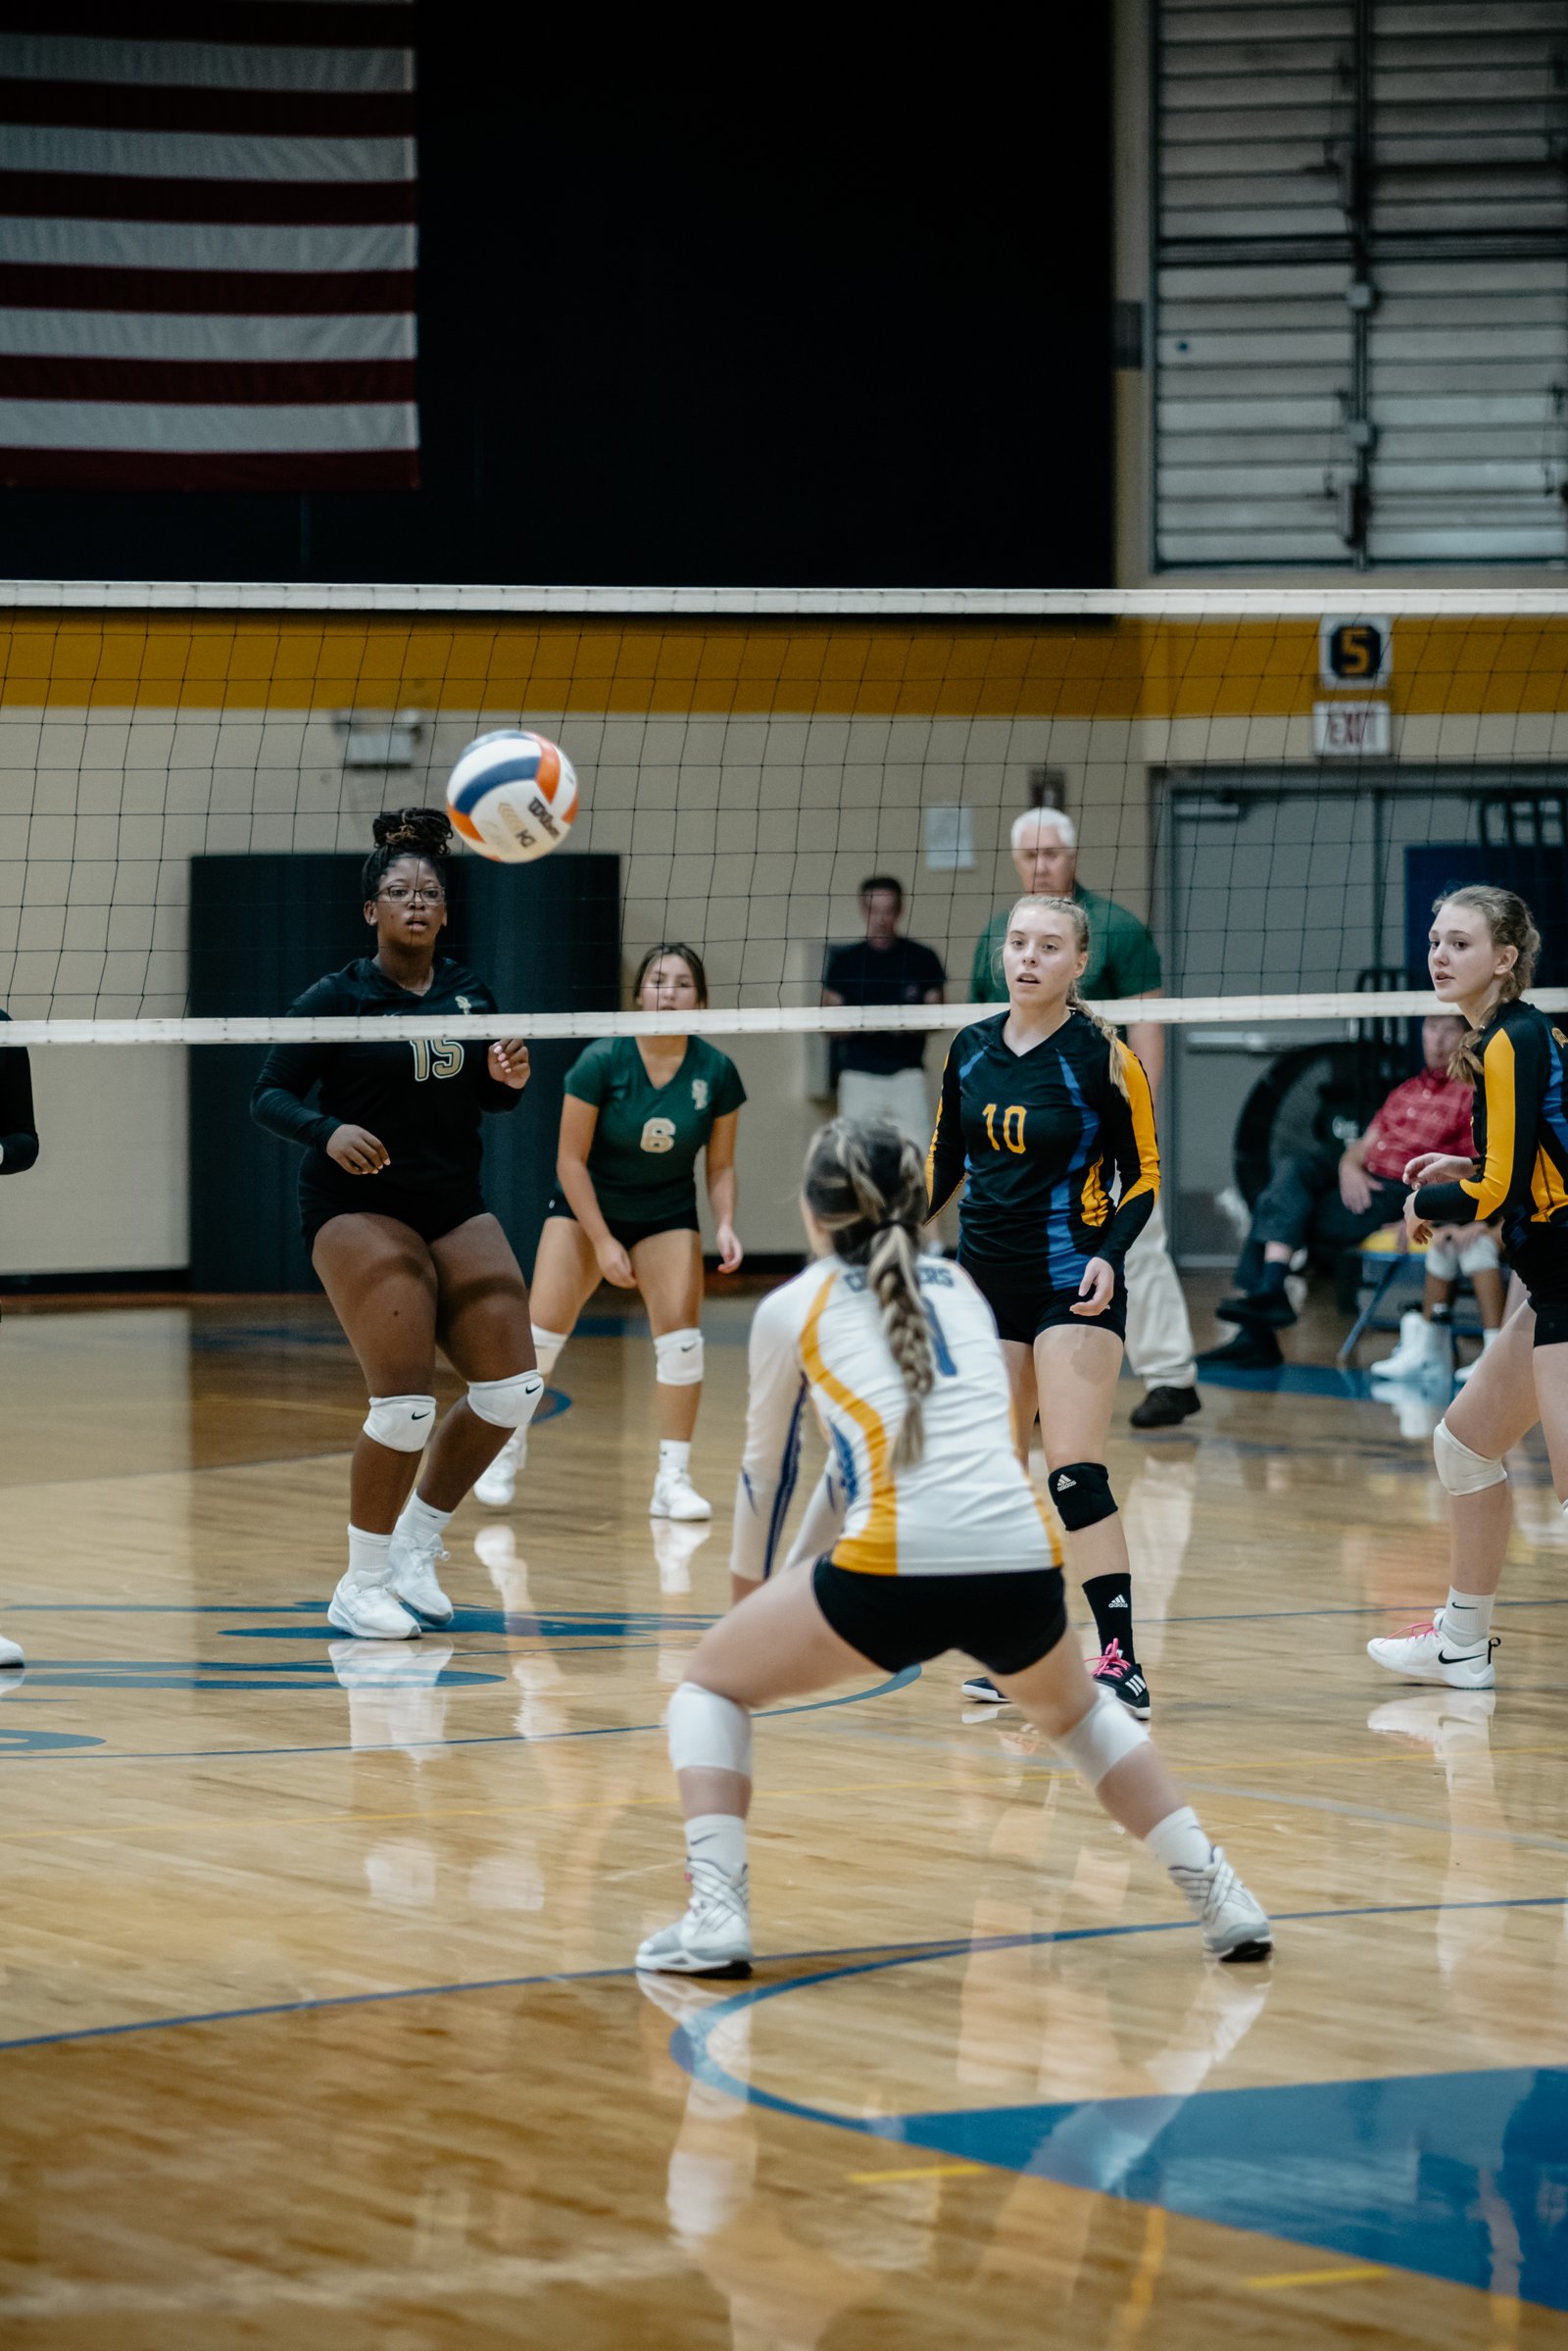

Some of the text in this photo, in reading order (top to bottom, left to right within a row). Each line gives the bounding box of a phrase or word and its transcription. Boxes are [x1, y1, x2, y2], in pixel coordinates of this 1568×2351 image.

[1340, 627, 1371, 675] 5
[1328, 711, 1377, 746] EXIT
[410, 1040, 465, 1082] 15
[640, 1117, 676, 1153] 6
[982, 1103, 1028, 1154] 10
